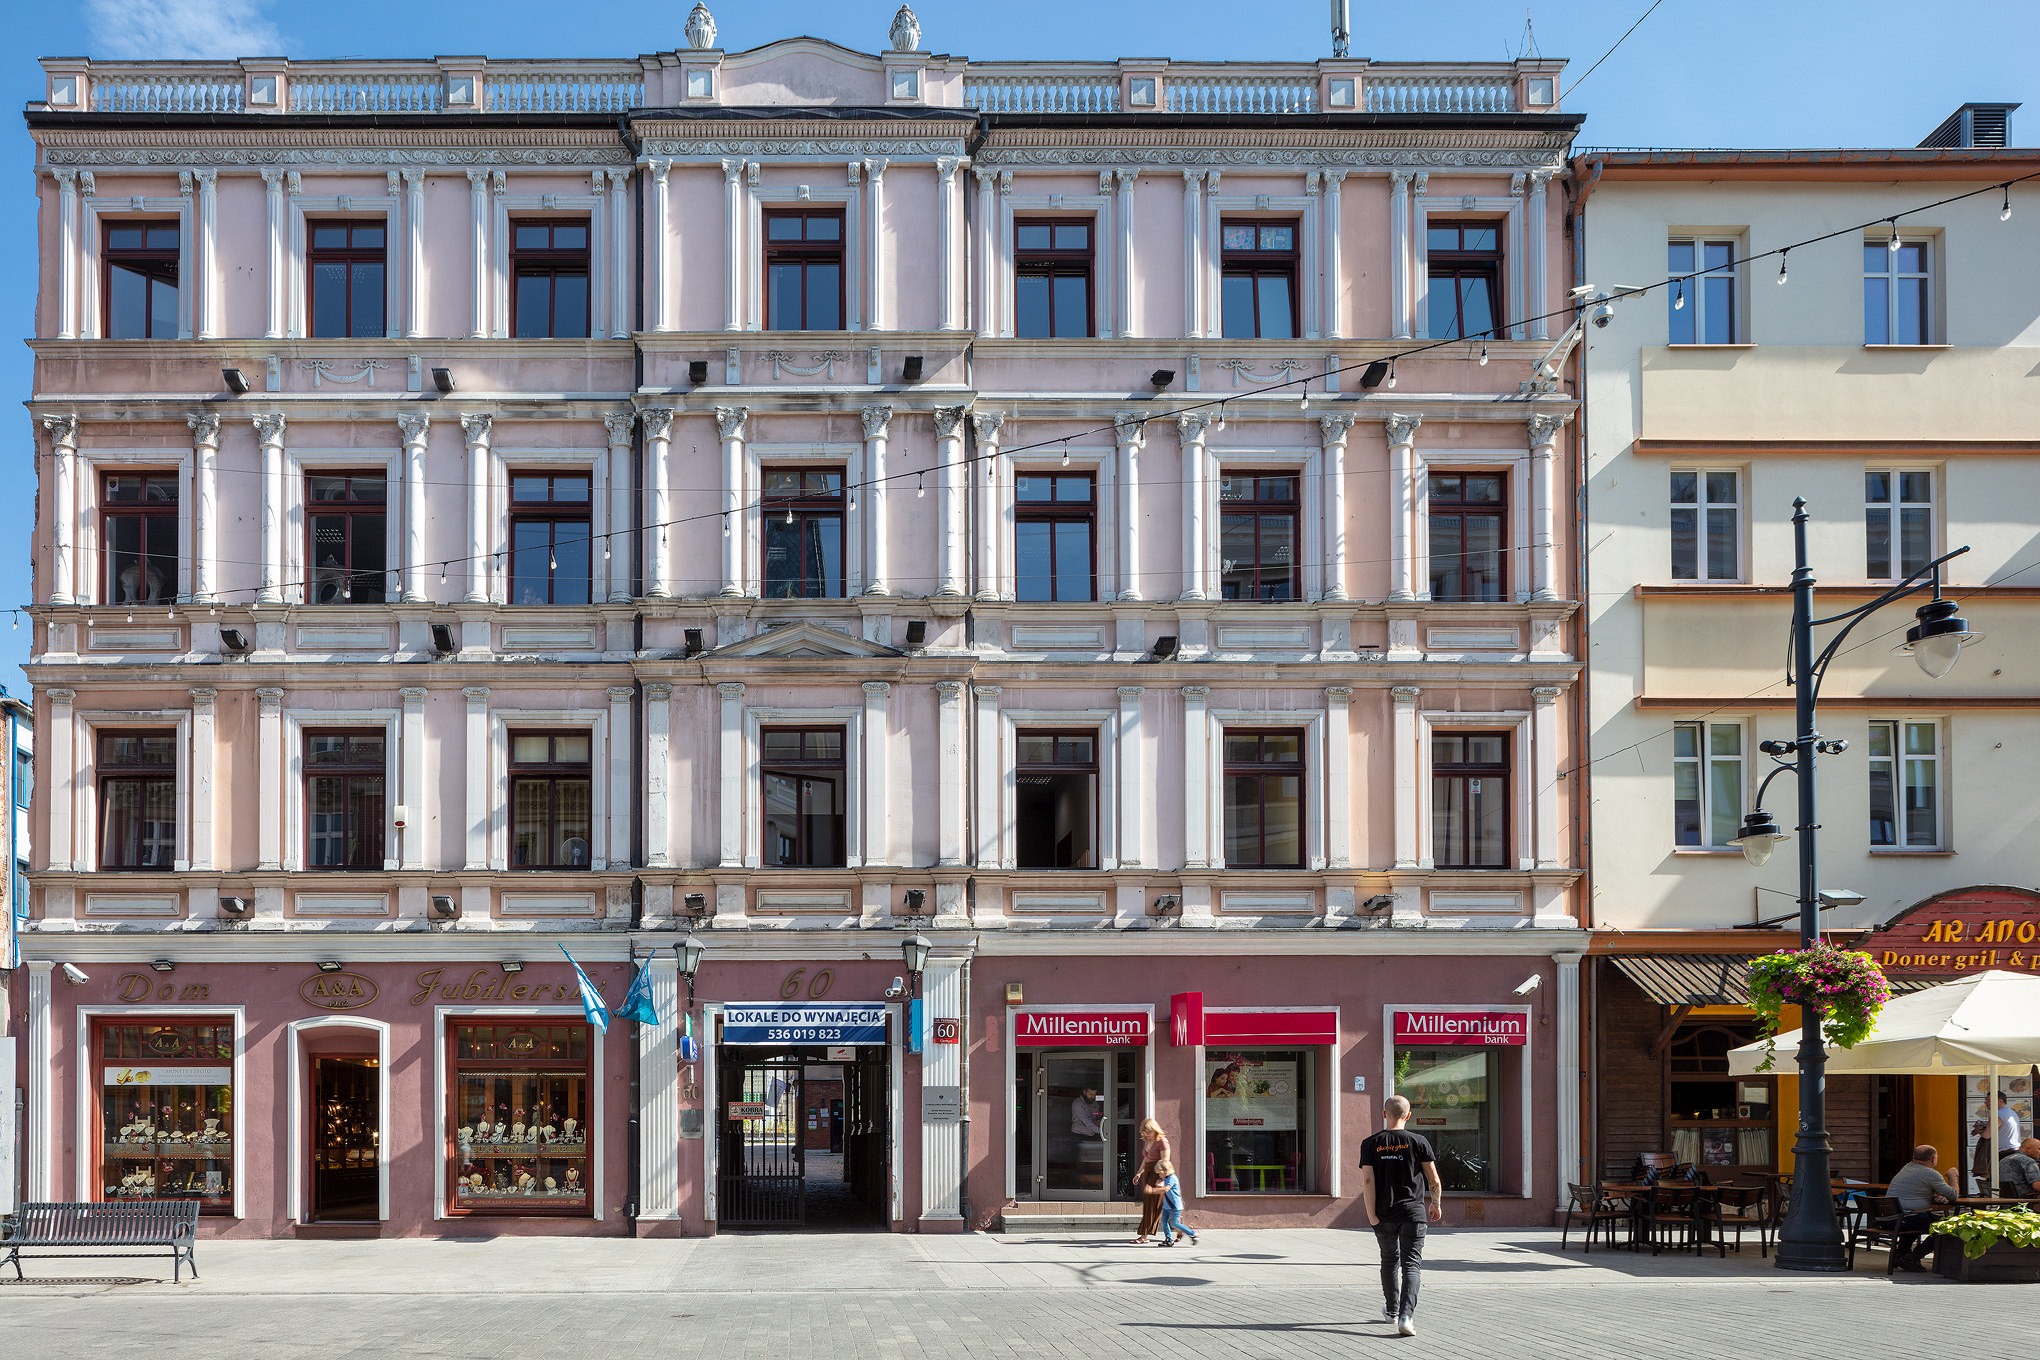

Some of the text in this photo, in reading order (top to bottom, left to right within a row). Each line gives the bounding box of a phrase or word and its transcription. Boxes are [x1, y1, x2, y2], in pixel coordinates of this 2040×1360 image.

[1973, 919, 2040, 944] ANO
[1882, 950, 1950, 967] Doner
[2008, 950, 2025, 966] &
[118, 972, 212, 1002] Dom
[313, 977, 365, 997] A&A
[780, 967, 835, 998] 60
[728, 1011, 881, 1025] LOKALE DO WYNAJĘCIA
[1026, 1013, 1141, 1034] Millennium
[1406, 1012, 1520, 1033] Millennium
[768, 1029, 841, 1040] 536 019 823
[937, 1023, 955, 1038] 60
[1106, 1035, 1131, 1044] bank
[1484, 1035, 1510, 1044] bank
[682, 1084, 701, 1100] 60
